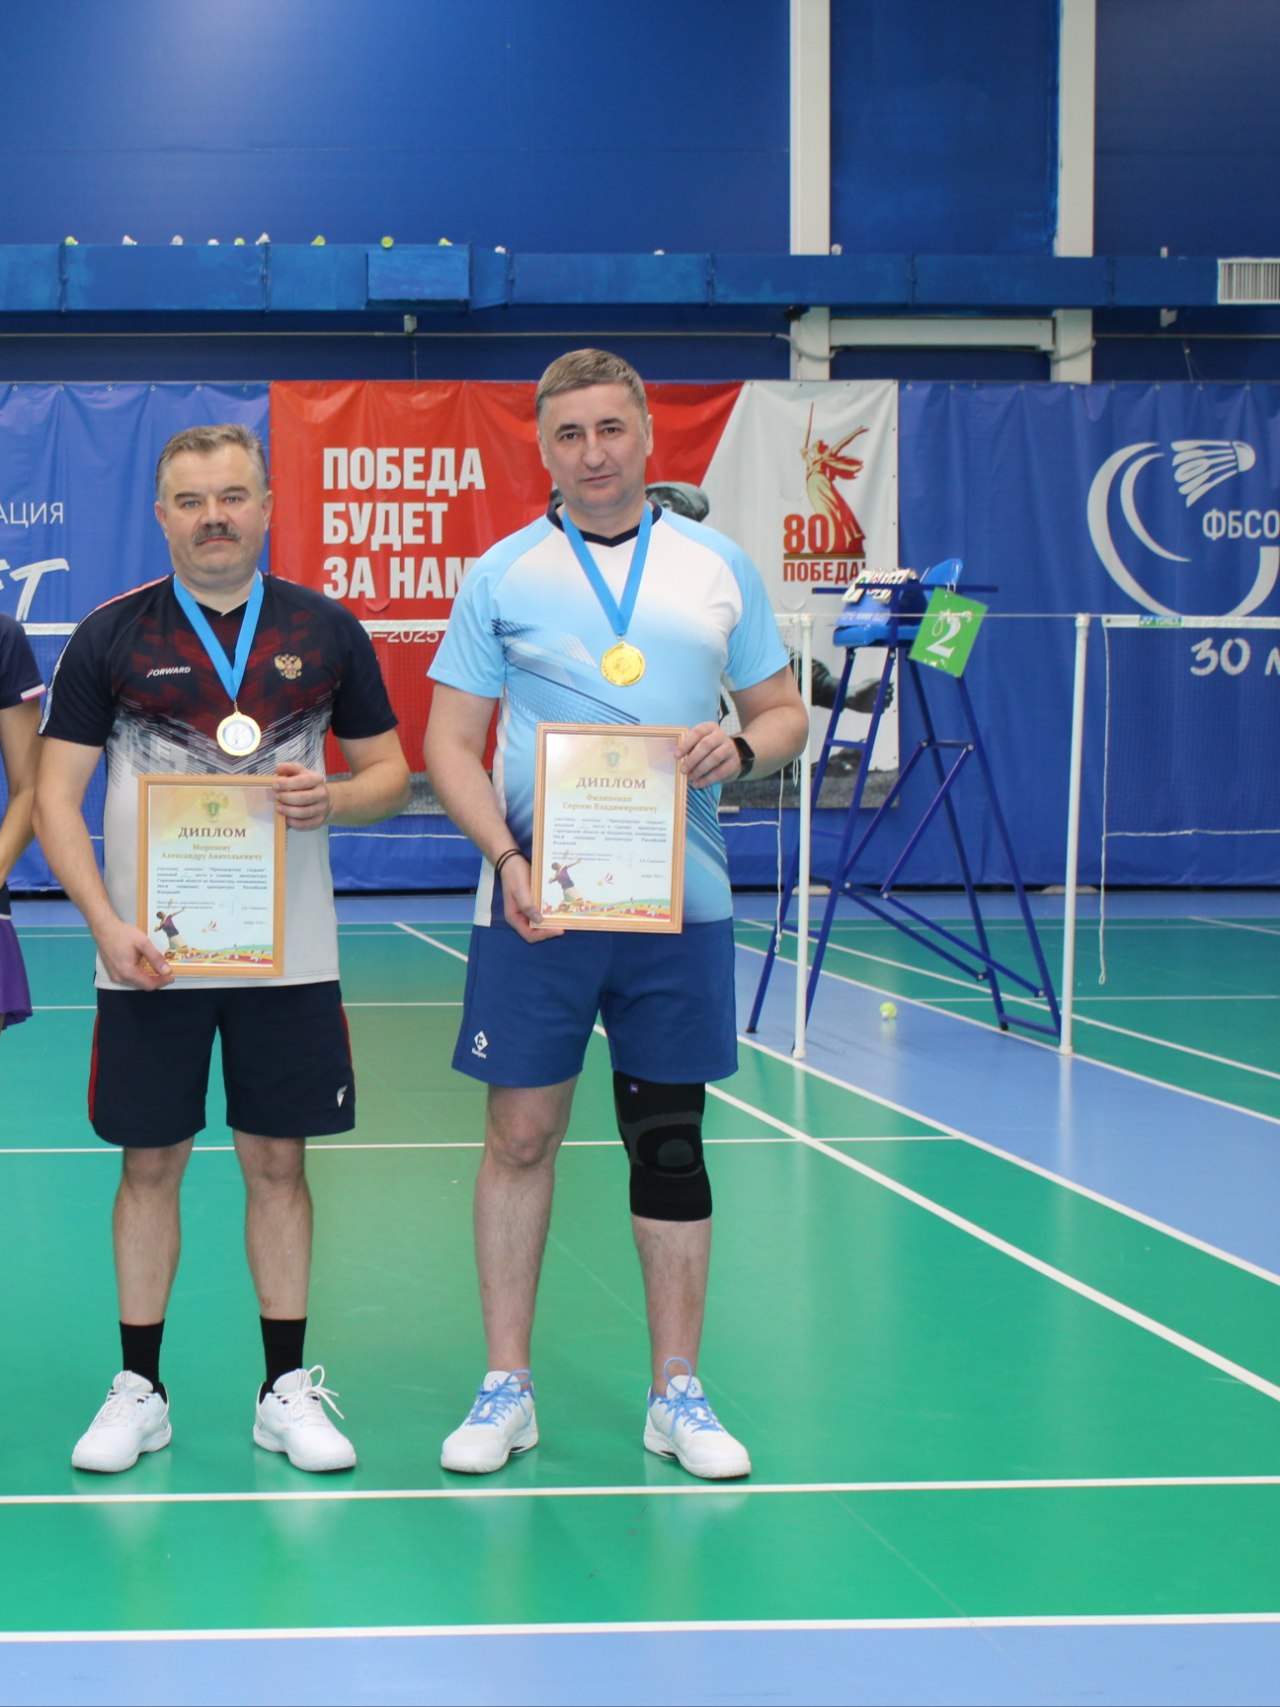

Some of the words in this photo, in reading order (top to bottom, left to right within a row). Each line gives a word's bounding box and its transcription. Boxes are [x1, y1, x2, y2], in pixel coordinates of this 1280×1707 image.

[323, 447, 485, 496] ПОБЕДА
[323, 502, 448, 552] БУДЕТ
[784, 514, 830, 553] 80
[1202, 508, 1280, 541] ФБСО
[322, 556, 376, 600] ЗА
[389, 556, 479, 600] НАМ
[926, 612, 962, 658] 2
[1190, 637, 1251, 676] 30
[576, 776, 647, 789] ДИПЛОМ
[178, 827, 246, 839] ДИПЛОМ
